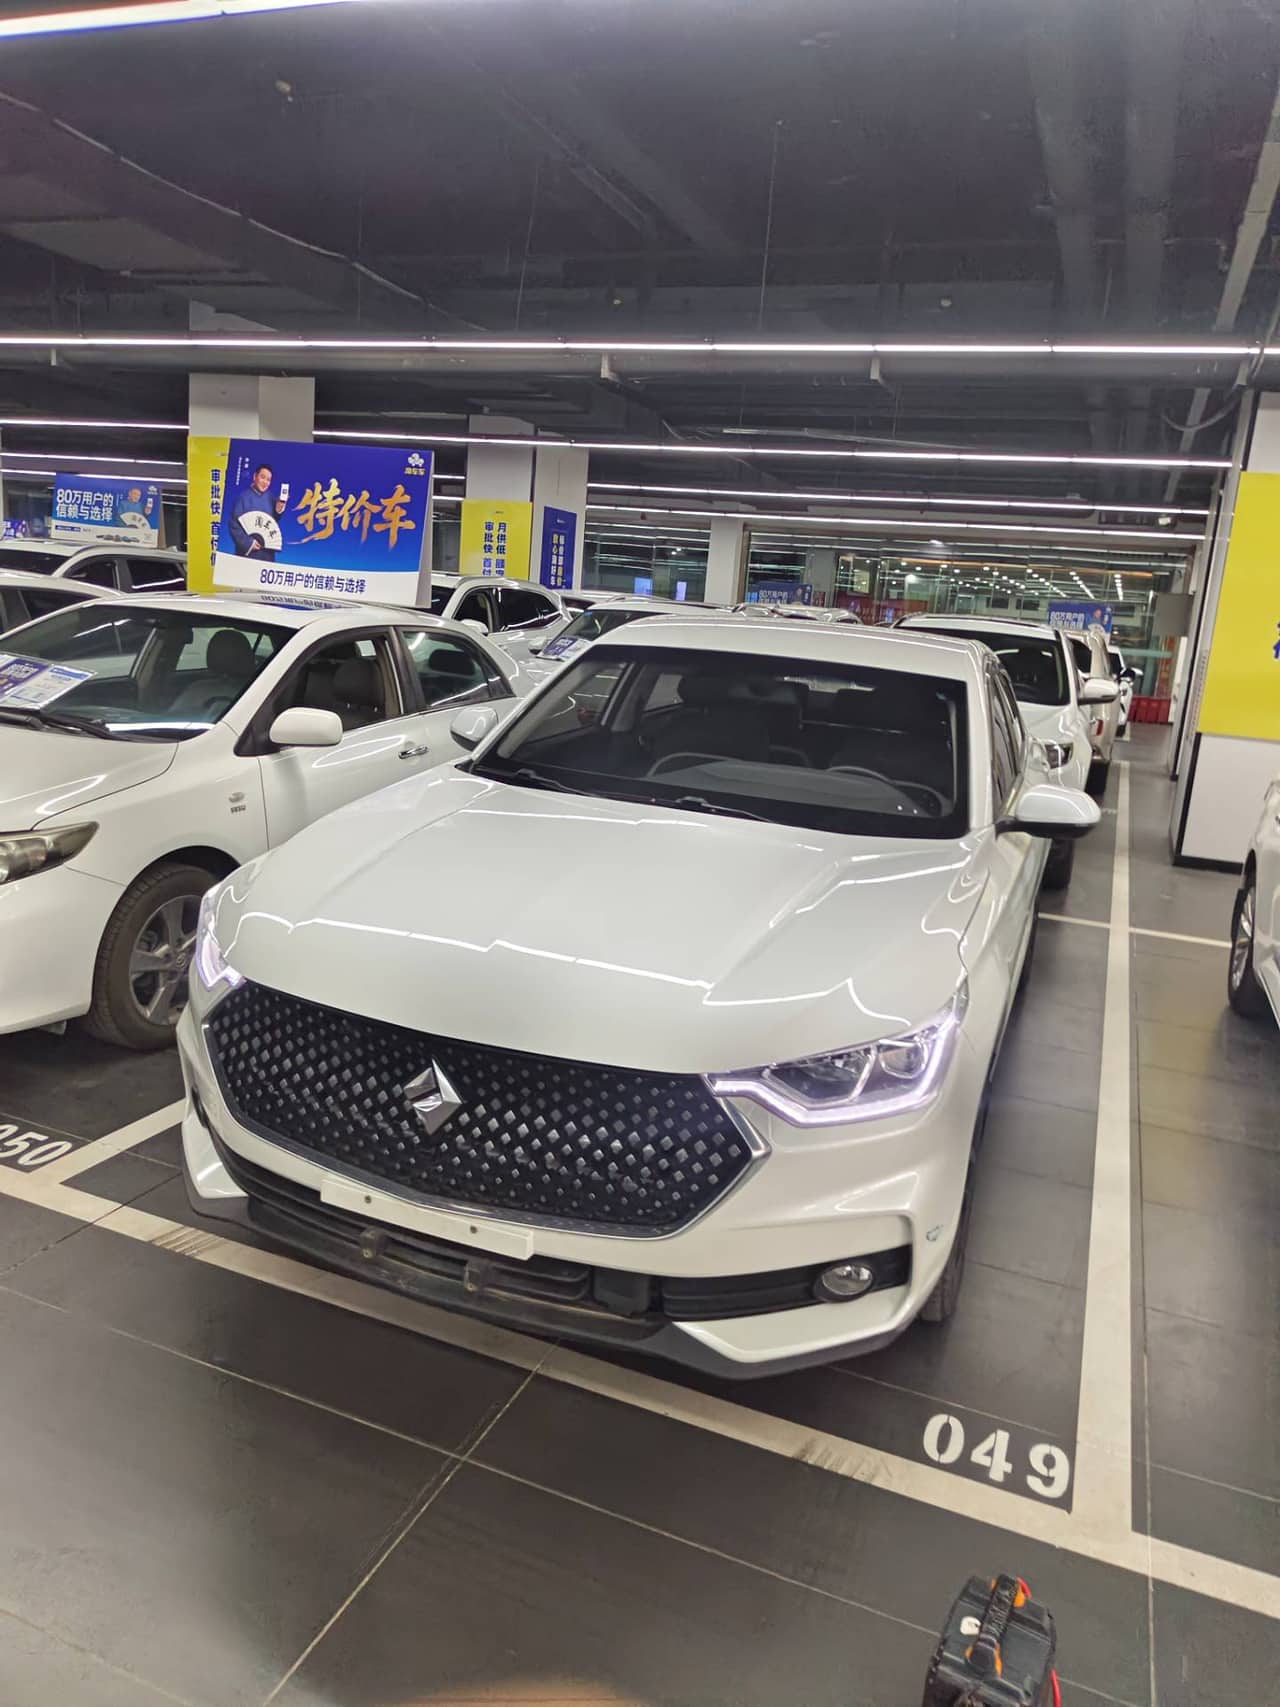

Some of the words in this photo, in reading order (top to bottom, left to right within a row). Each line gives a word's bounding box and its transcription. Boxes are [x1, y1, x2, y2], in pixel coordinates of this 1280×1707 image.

[57, 488, 114, 507] 80万用户的
[56, 503, 113, 522] 信赖与选择
[288, 477, 416, 549] 特价车
[259, 568, 367, 595] 80万用户的信赖与选择
[923, 1413, 1071, 1499] 049
